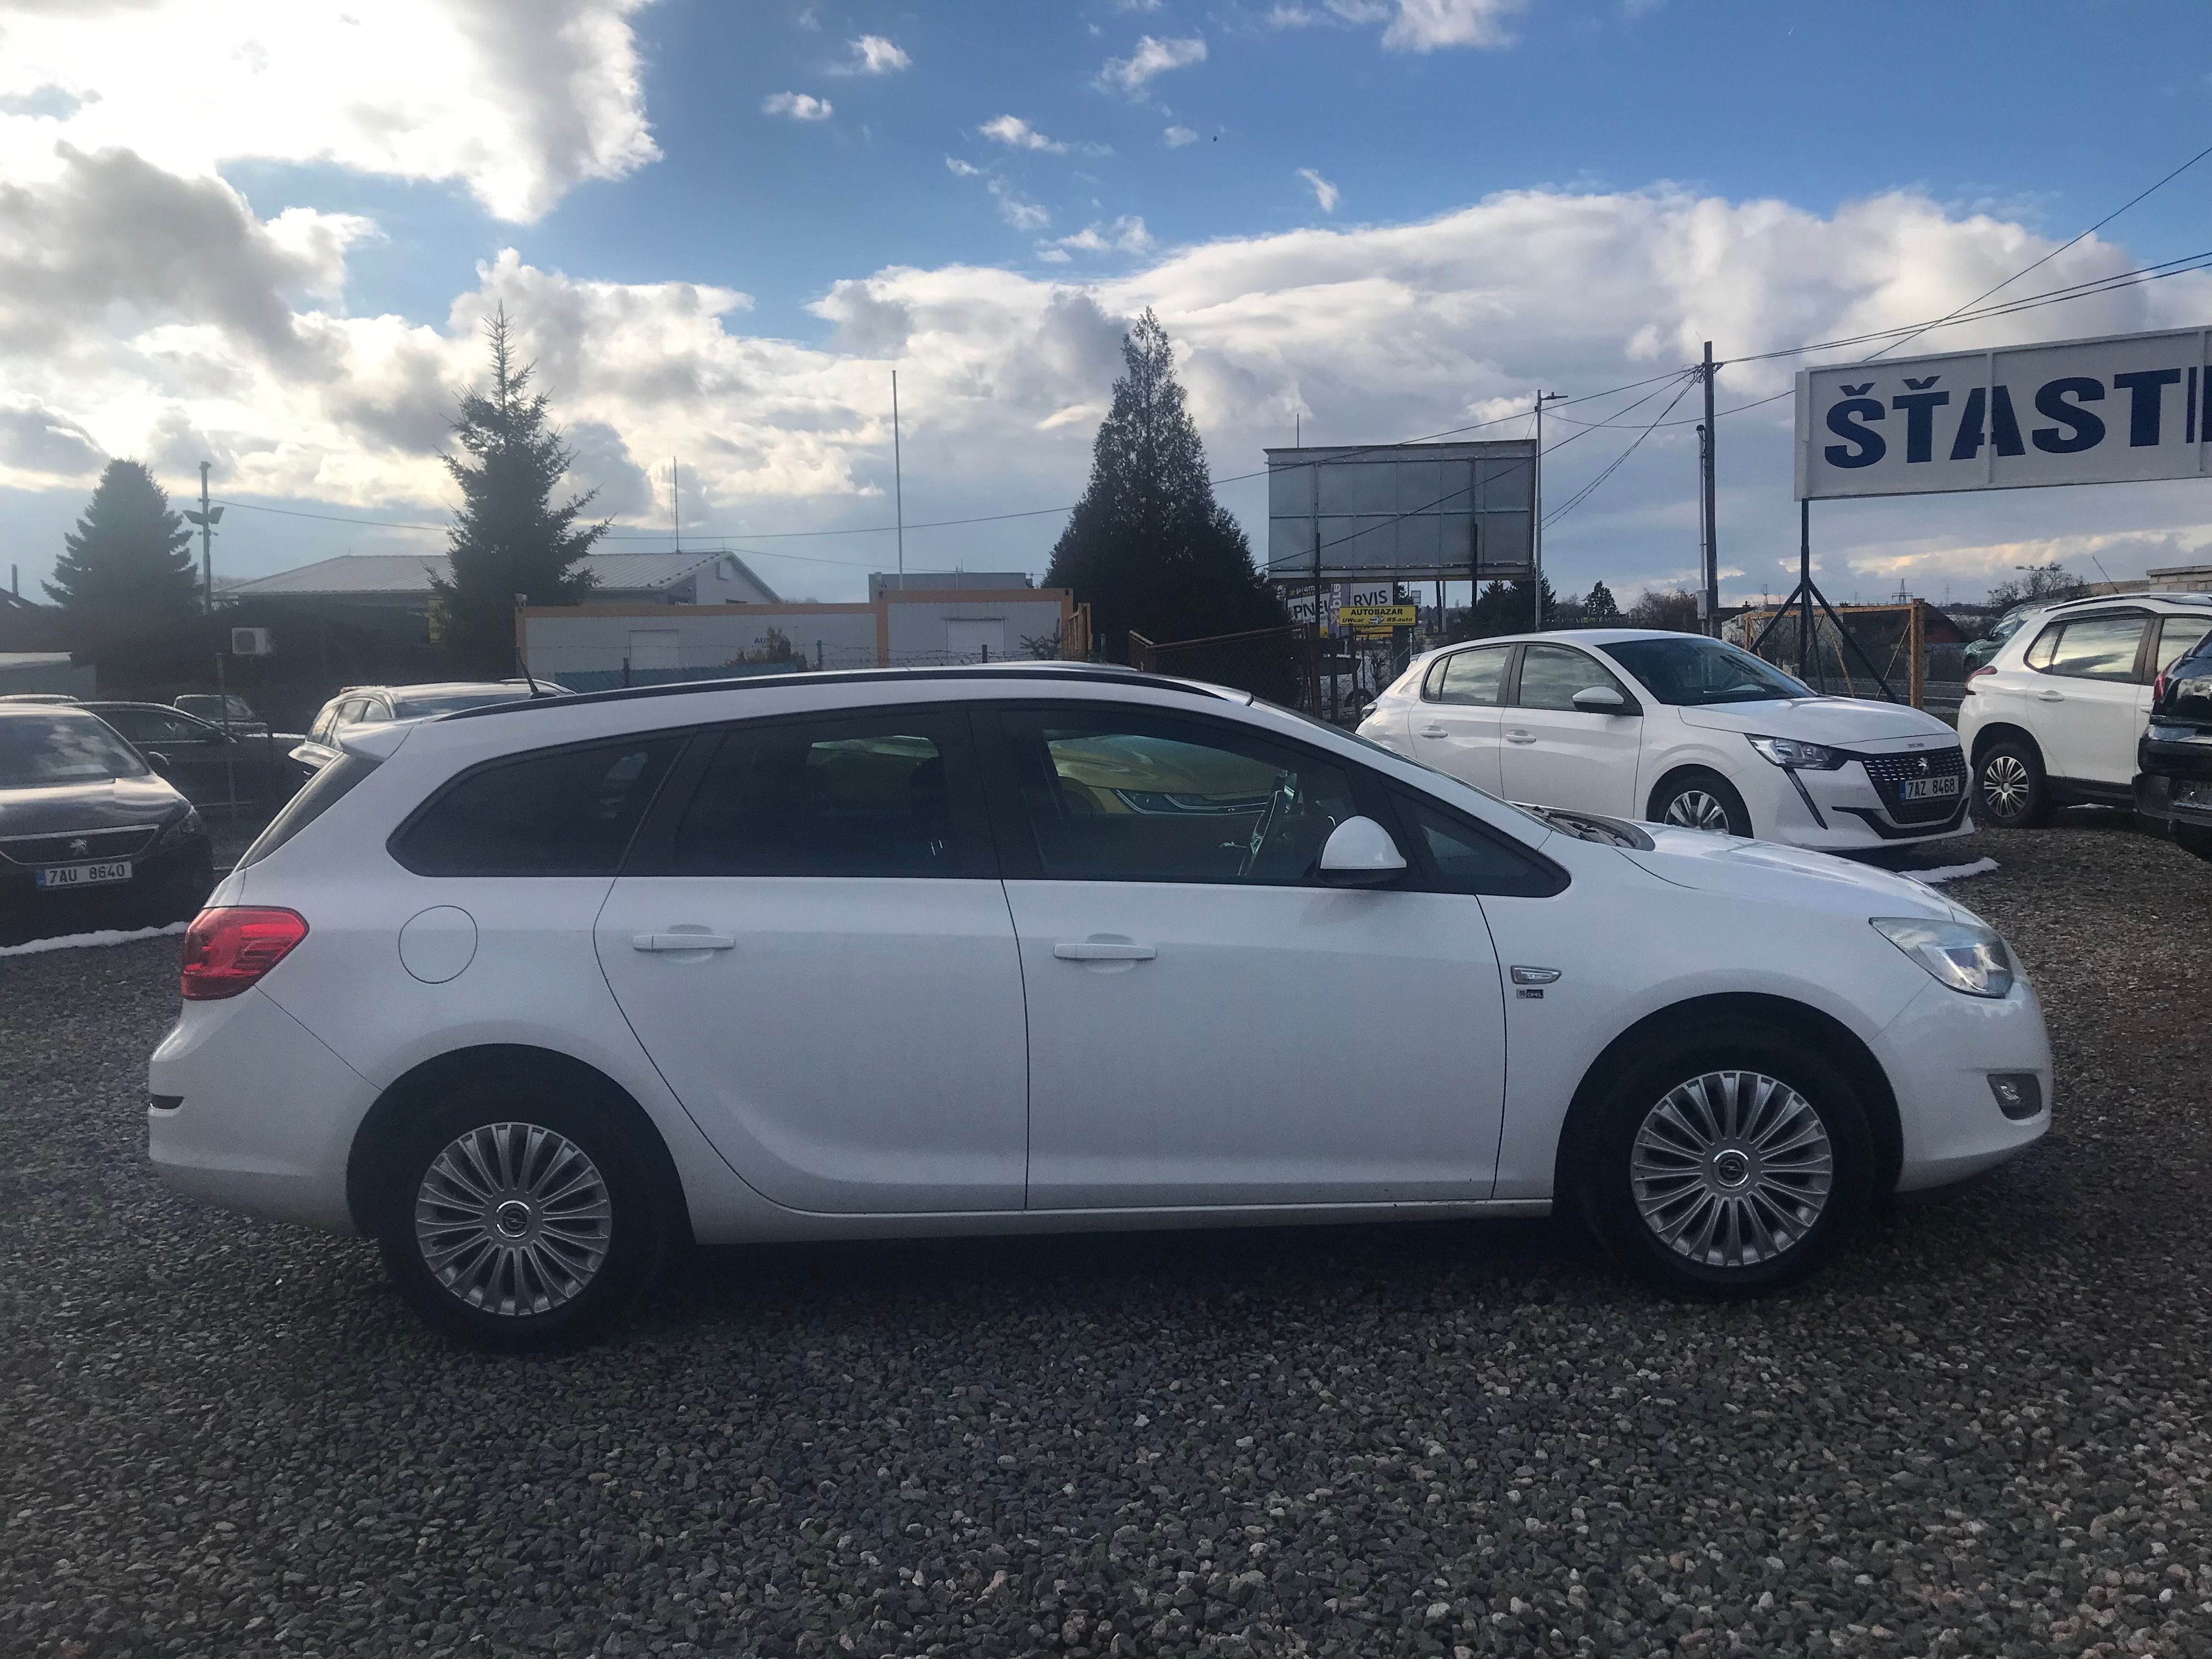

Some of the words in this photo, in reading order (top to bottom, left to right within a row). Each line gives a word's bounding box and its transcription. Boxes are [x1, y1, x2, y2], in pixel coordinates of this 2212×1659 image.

[1908, 781, 1926, 798] 7AZ
[1933, 778, 1955, 794] 8468
[49, 868, 77, 883] 7AU
[89, 864, 125, 879] 8640
